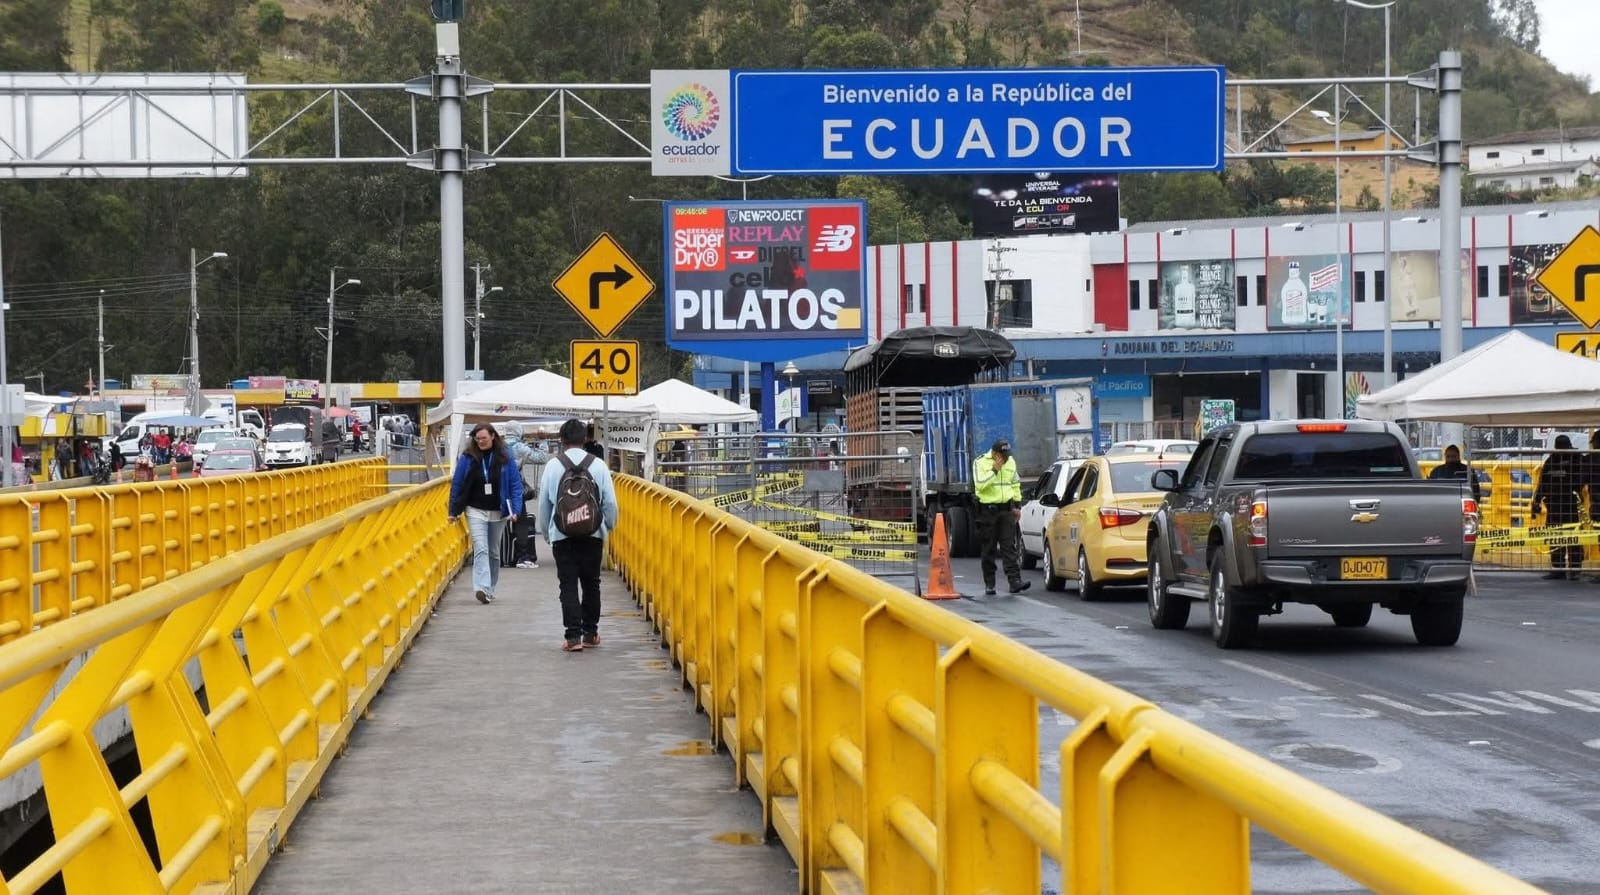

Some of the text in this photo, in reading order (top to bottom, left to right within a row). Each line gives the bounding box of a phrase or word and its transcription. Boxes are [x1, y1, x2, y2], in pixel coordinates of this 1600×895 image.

[823, 82, 1132, 106] Bienvenido a la República del
[823, 117, 1132, 160] ECUADOR
[662, 142, 720, 156] ecuador
[1008, 199, 1022, 207] DA
[1025, 198, 1037, 206] LA
[1039, 196, 1093, 205] BIENVENIDA
[1026, 204, 1071, 213] ECUOR
[739, 209, 804, 222] NEWPROJECT
[674, 229, 724, 253] Super
[728, 225, 805, 242] REPLAY
[675, 288, 846, 331] PILATOS
[1199, 314, 1222, 328] WANT
[1114, 339, 1234, 354] ADUANA DEL ECUADOR
[1569, 339, 1600, 361] 4
[579, 347, 631, 375] 40
[586, 378, 626, 391] km/h
[764, 479, 799, 495] PELIGRO
[713, 491, 748, 507] PELIGRO
[566, 503, 591, 526] NIKE
